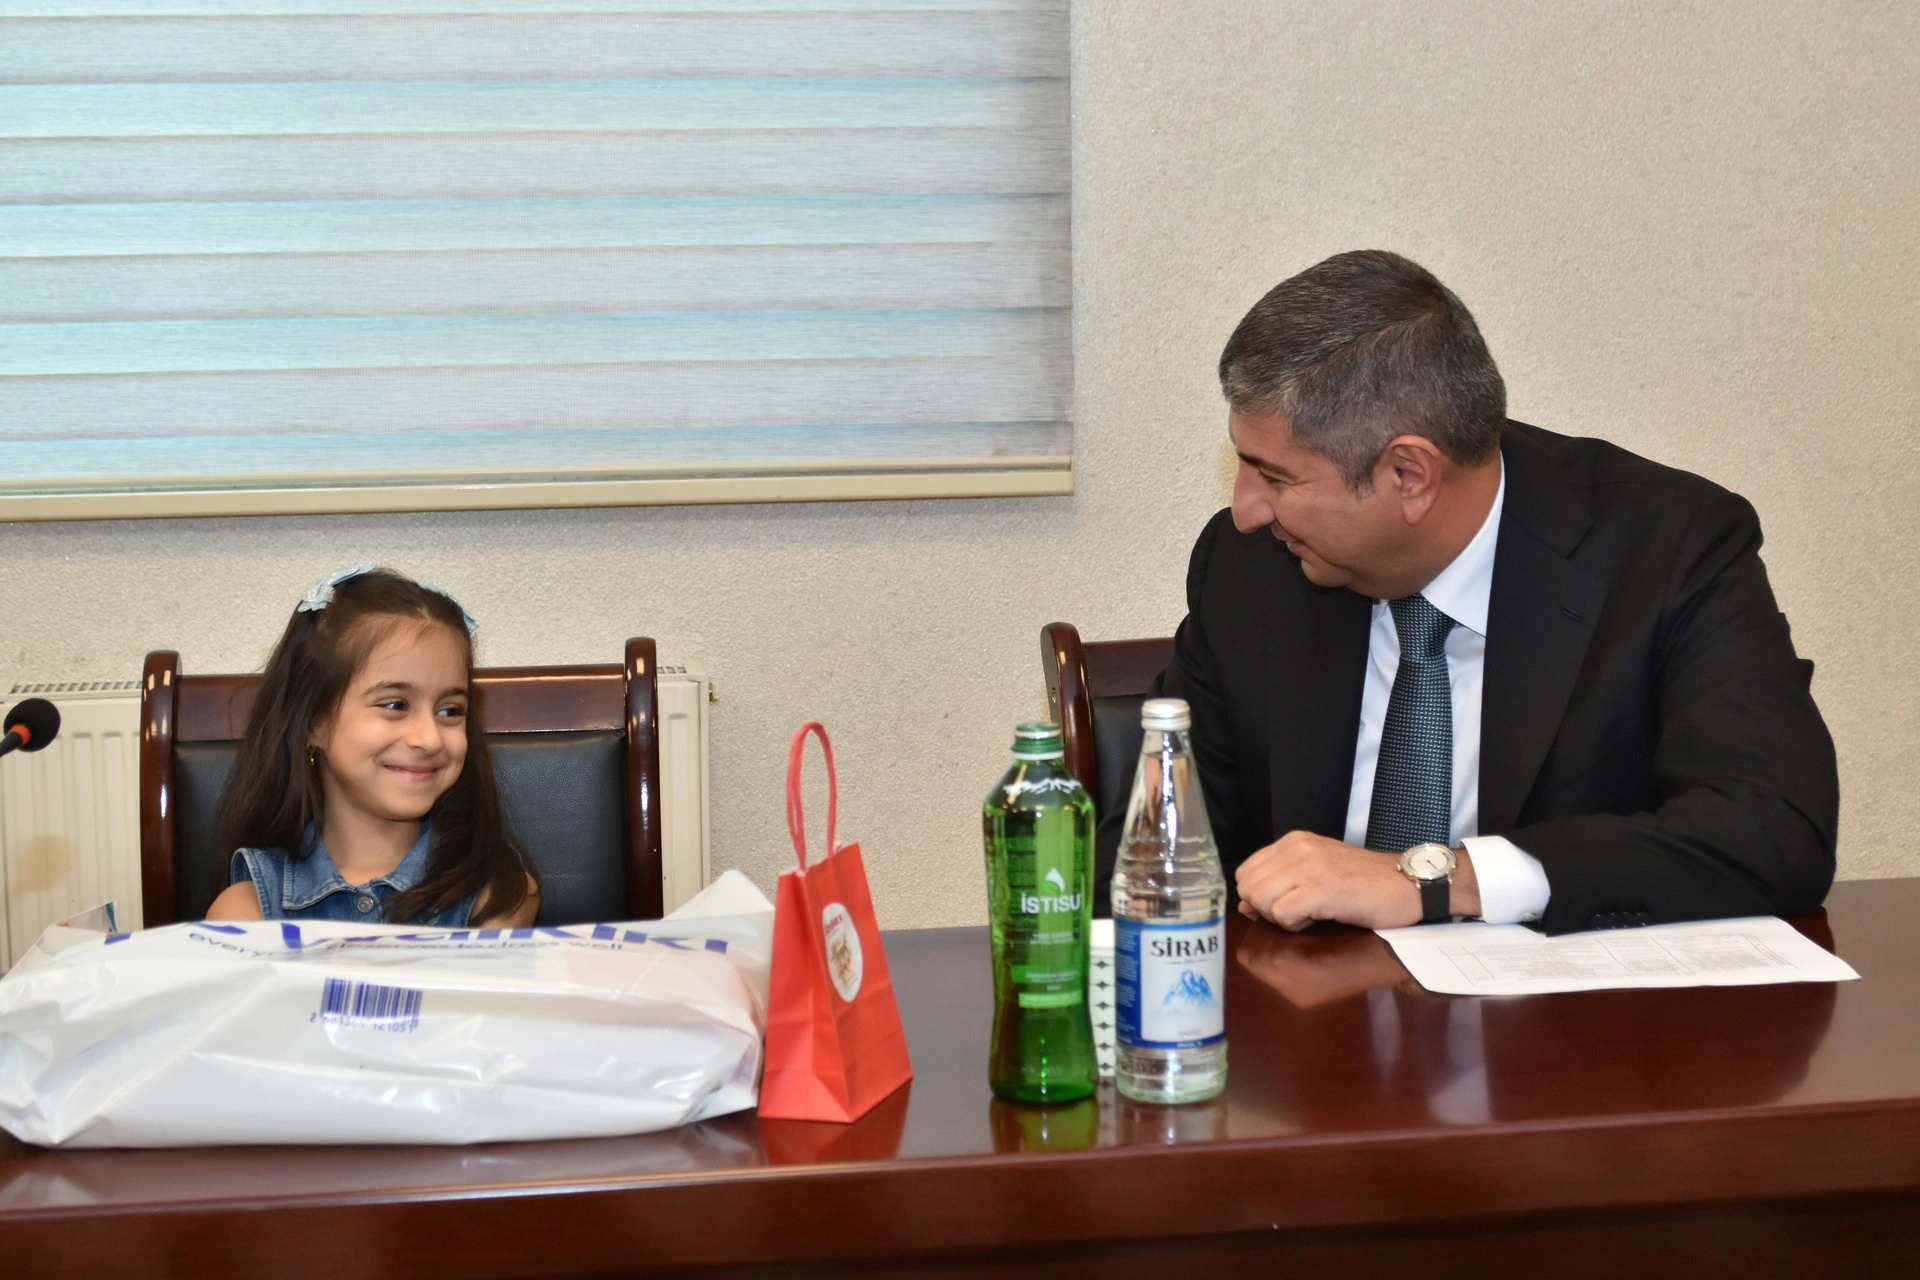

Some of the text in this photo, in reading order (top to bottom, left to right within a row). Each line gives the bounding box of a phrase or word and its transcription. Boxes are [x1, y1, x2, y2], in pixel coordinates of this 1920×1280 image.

[458, 942, 484, 950] to
[487, 940, 560, 949] dress
[568, 940, 624, 951] well
[309, 1012, 317, 1023] 2
